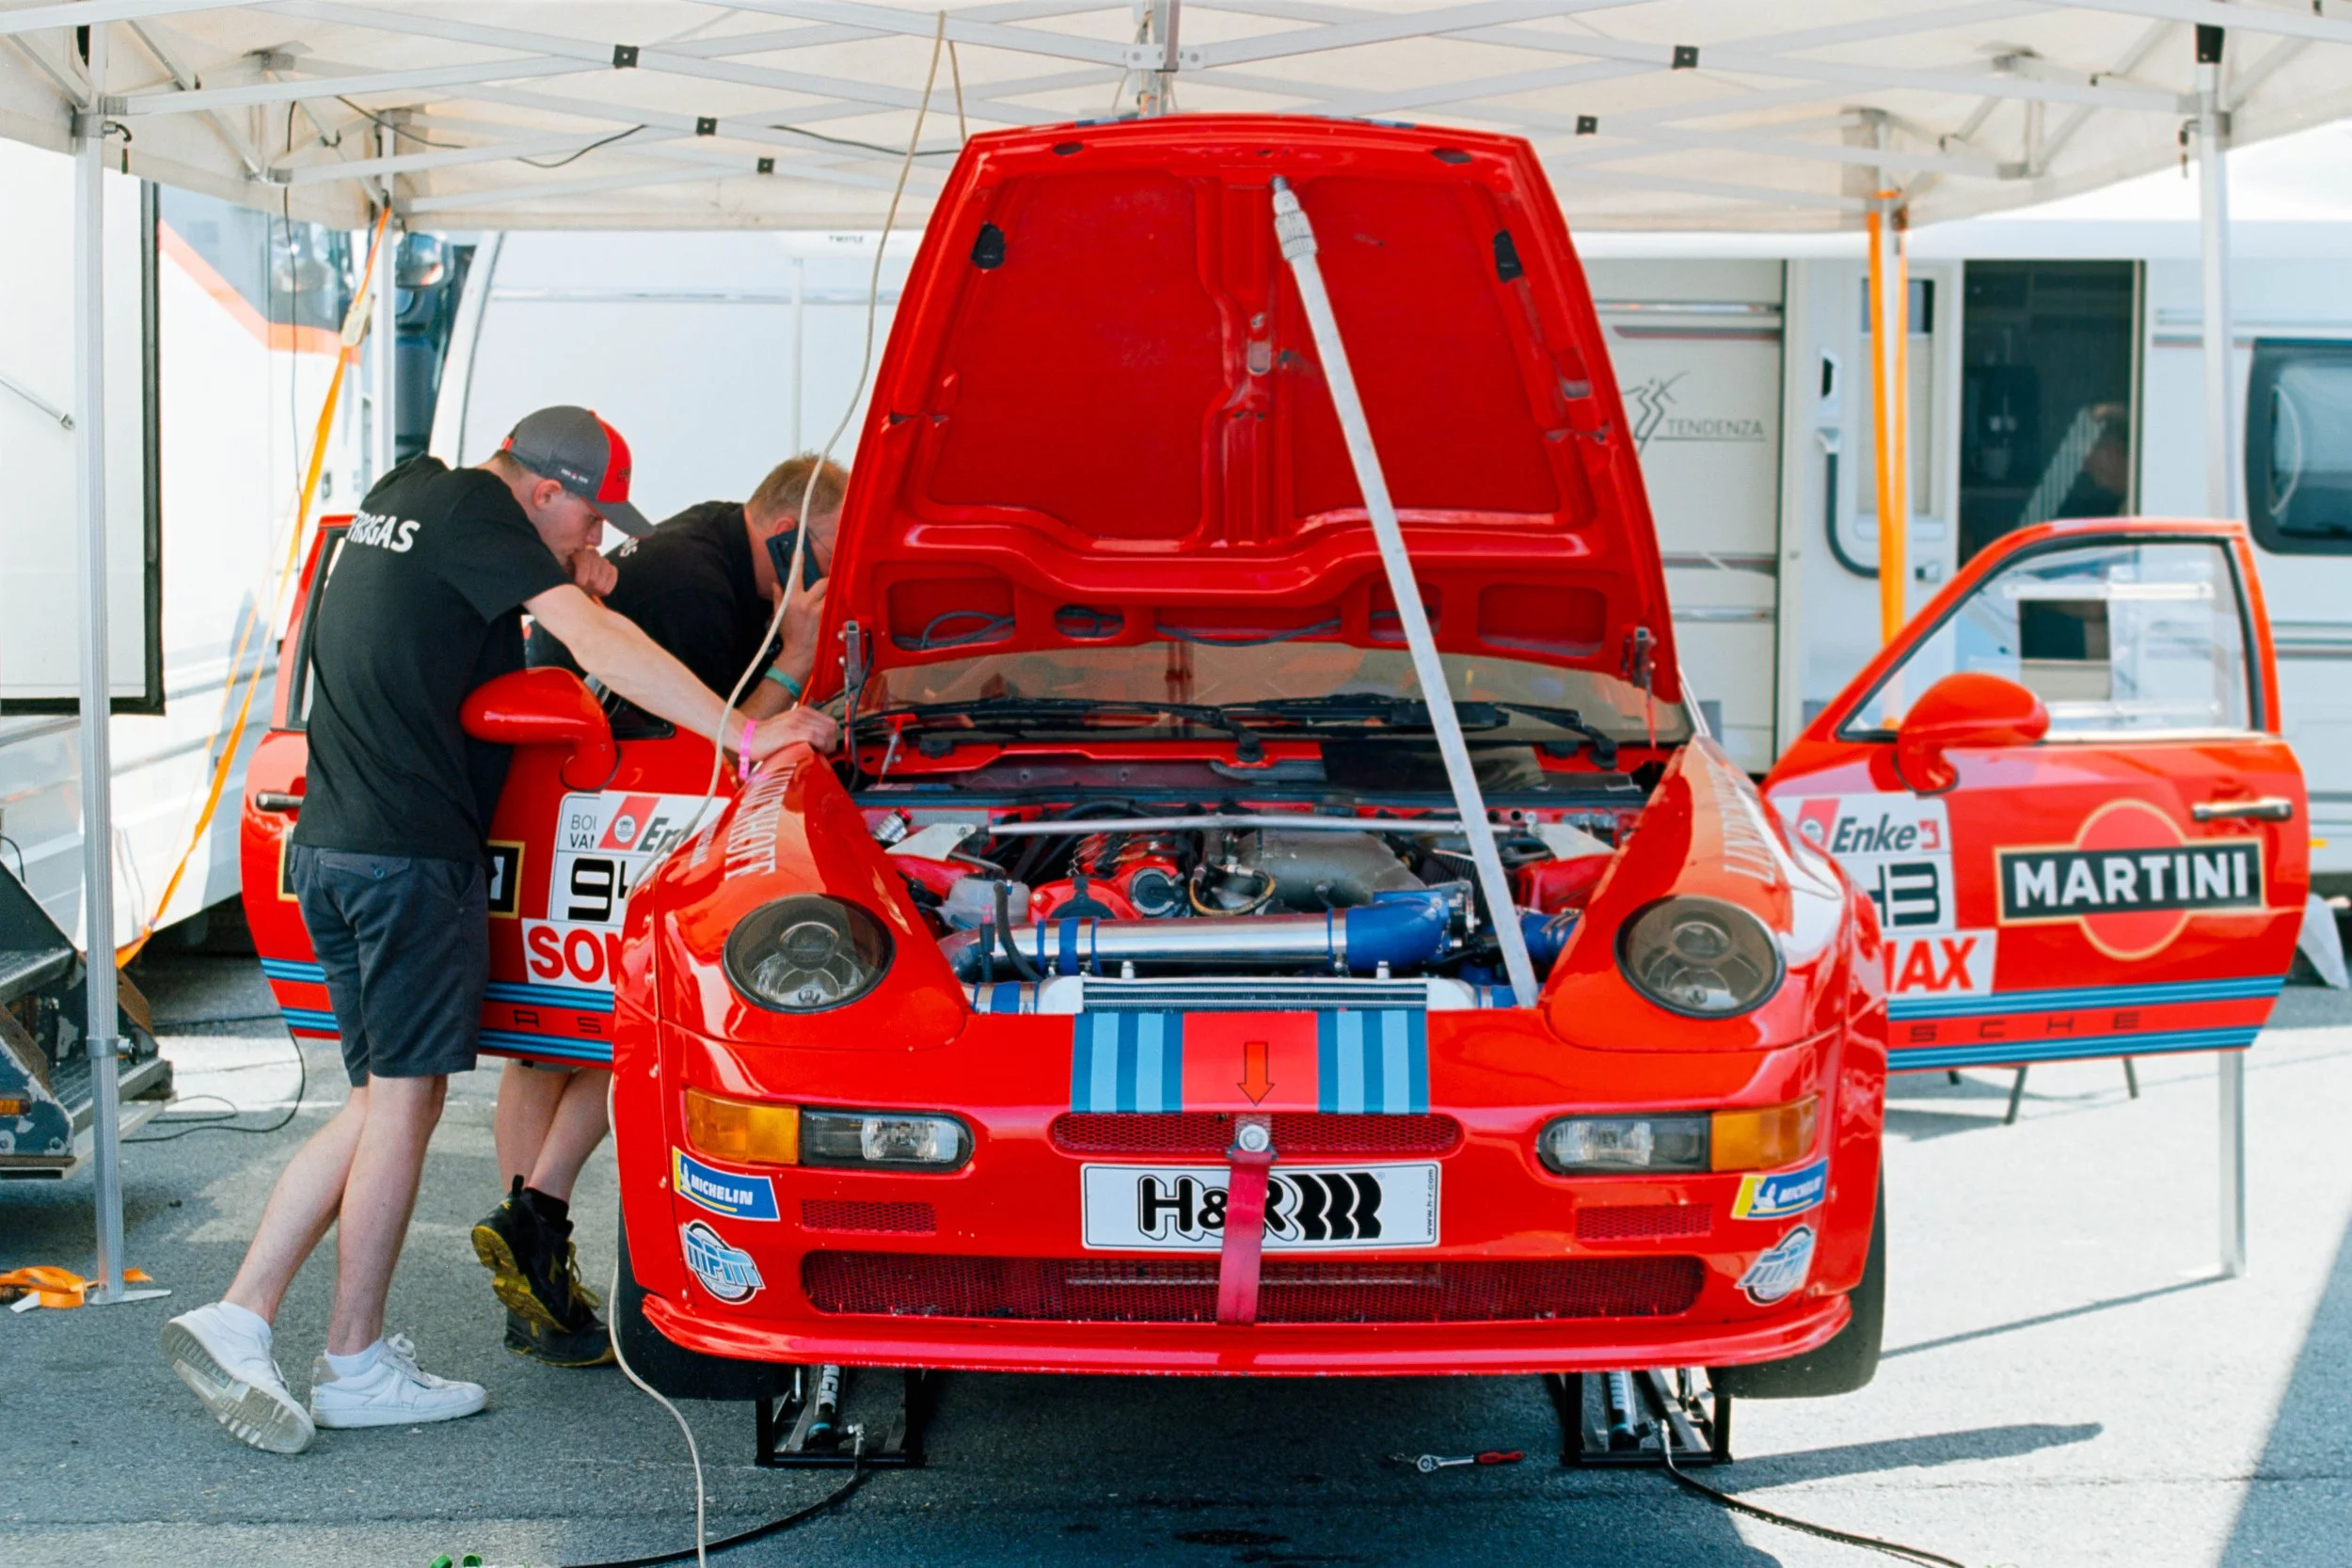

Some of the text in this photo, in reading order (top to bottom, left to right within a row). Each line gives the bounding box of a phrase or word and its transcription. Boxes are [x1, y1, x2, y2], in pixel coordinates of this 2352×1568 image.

[1668, 419, 1764, 436] TENDENZA
[2013, 852, 2249, 908] MARTINI
[691, 1173, 754, 1206] MICHELIN
[1425, 1168, 1435, 1236] www.h-r.com
